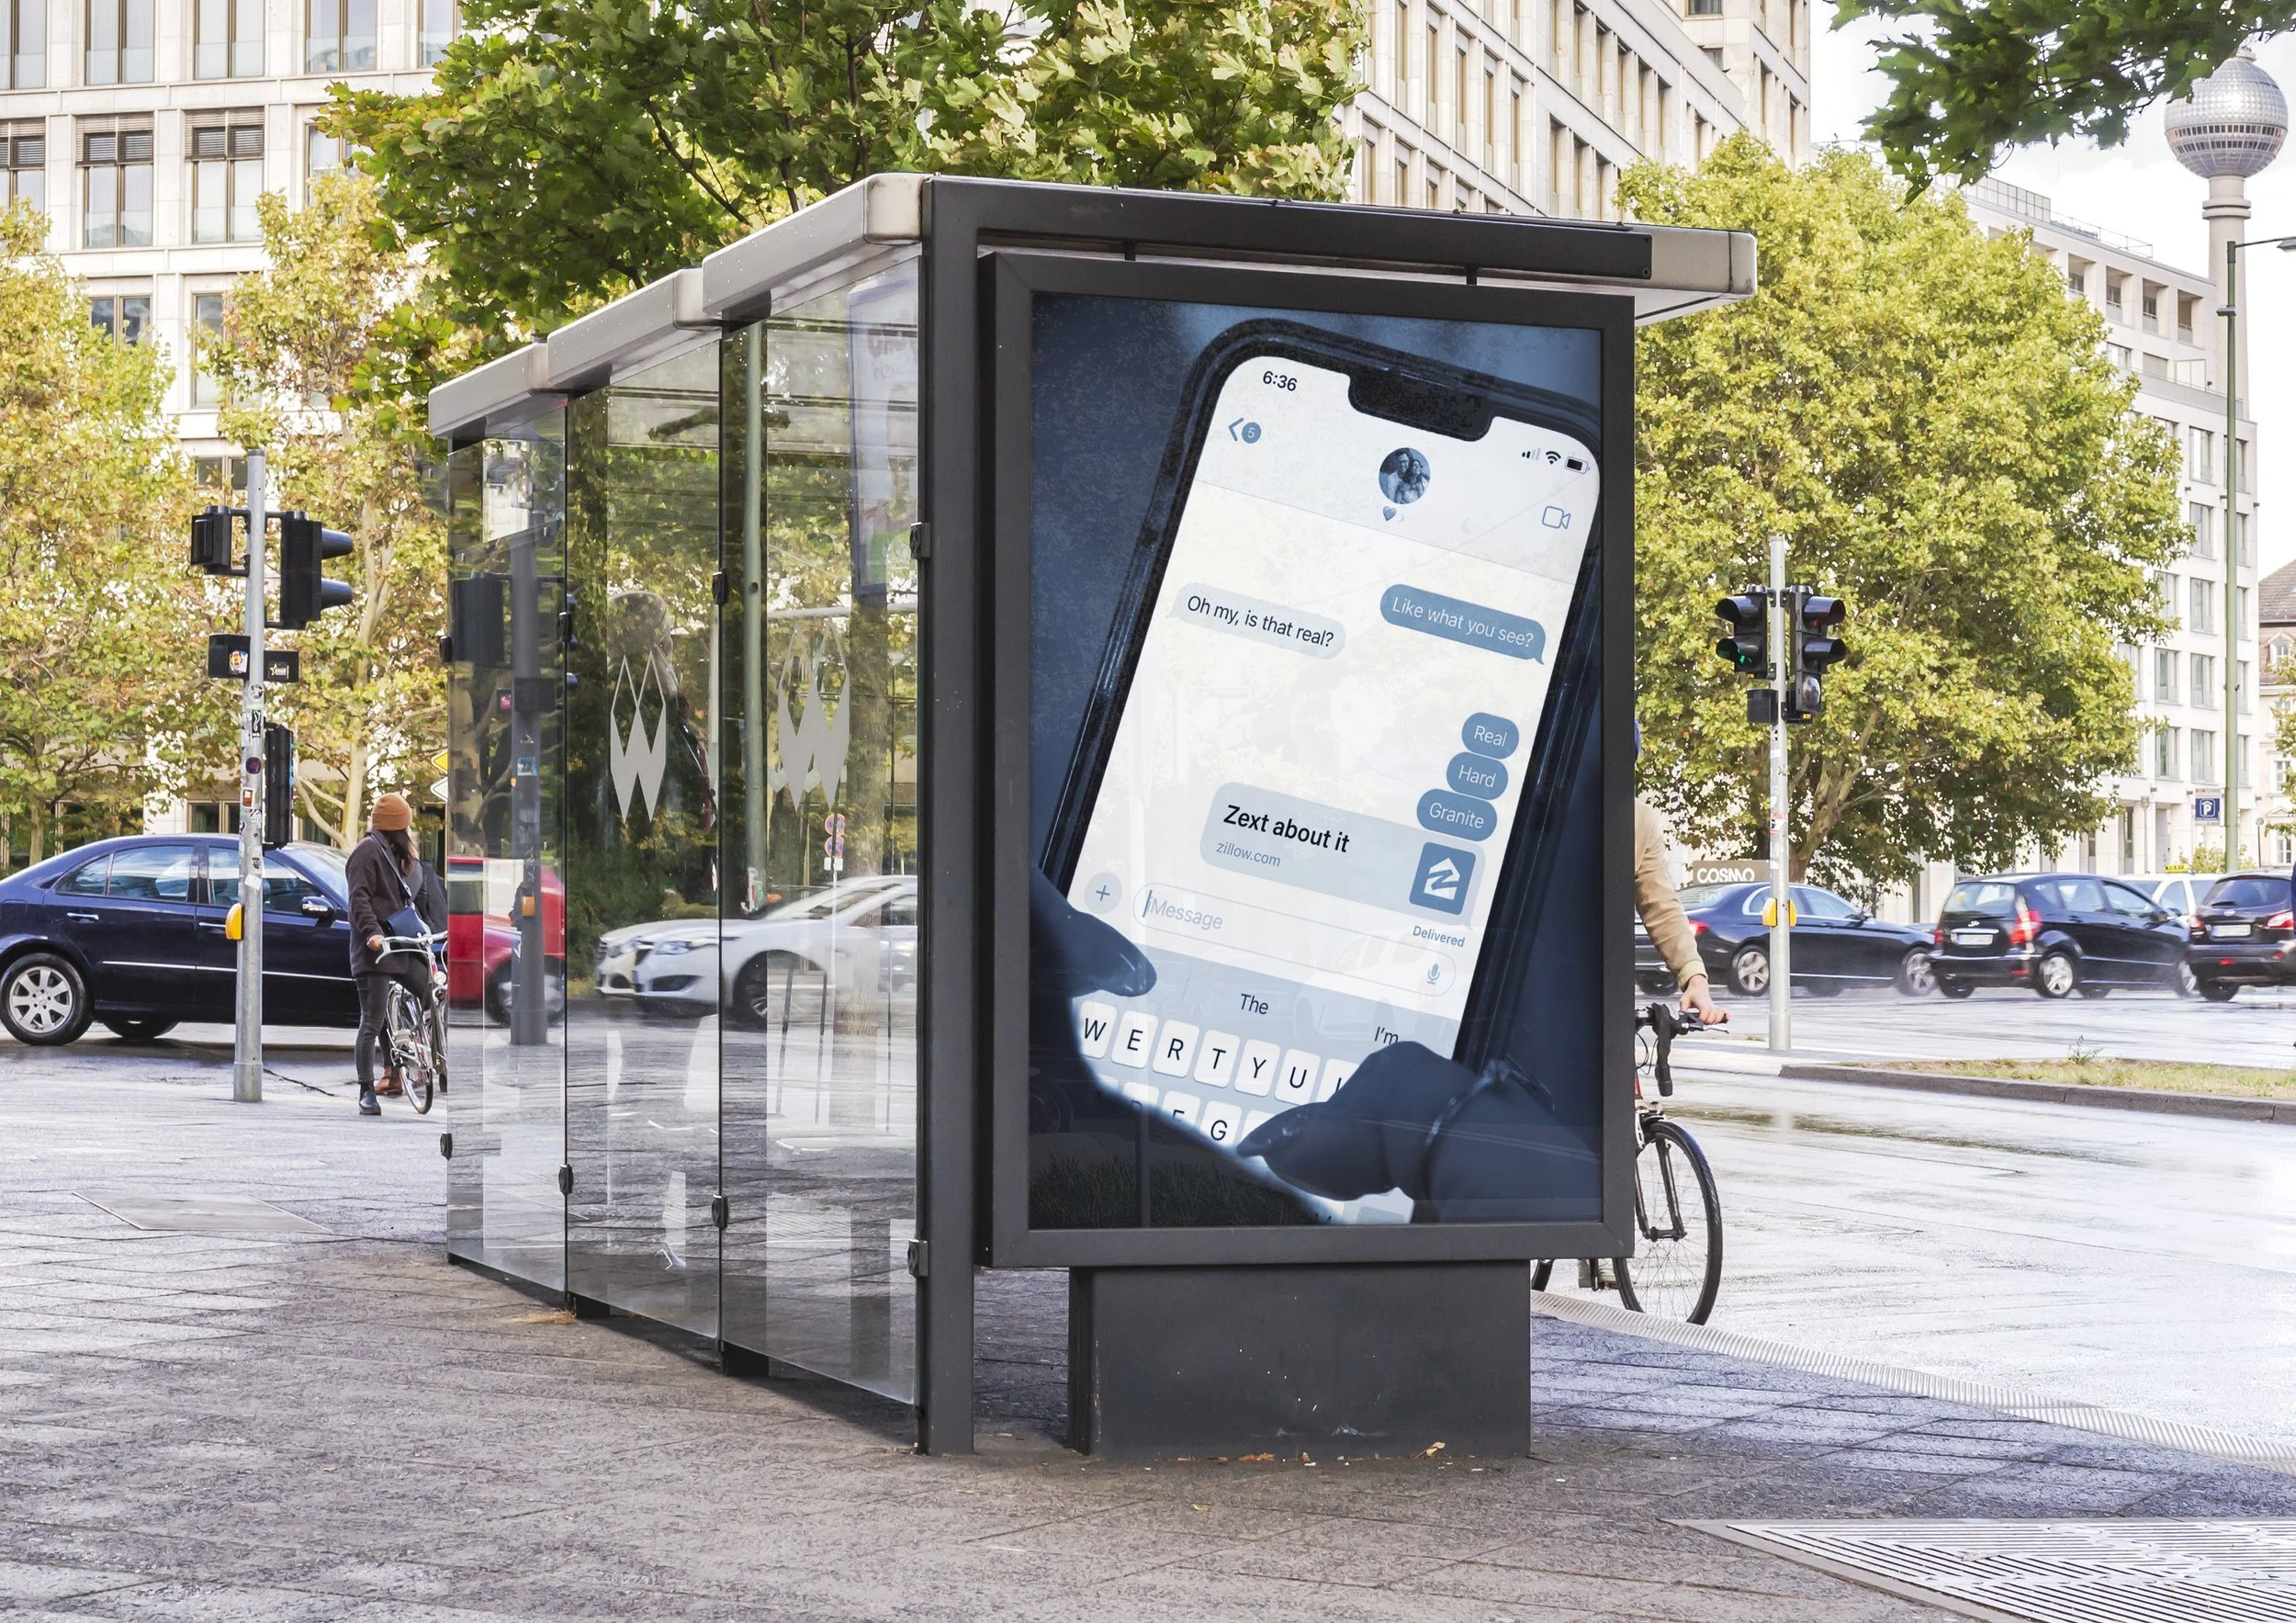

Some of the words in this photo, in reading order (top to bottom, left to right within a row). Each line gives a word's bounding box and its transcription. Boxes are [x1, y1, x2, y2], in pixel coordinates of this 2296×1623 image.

[1263, 370, 1298, 391] 6:36
[1246, 426, 1255, 439] 5
[1187, 595, 1210, 615] Oh
[1213, 604, 1239, 626] my,
[1244, 609, 1258, 627] is
[1262, 615, 1293, 637] that
[1296, 626, 1334, 648] real?
[1392, 596, 1424, 618] Like
[1427, 609, 1464, 629] what
[1466, 620, 1495, 638] you
[1497, 628, 1535, 648] see?
[1473, 725, 1508, 748] Real
[1458, 764, 1497, 788] Hard
[1429, 802, 1484, 829] Granite
[1223, 804, 1270, 833] Zext
[1272, 817, 1332, 849] about
[1334, 831, 1350, 853] it
[1216, 841, 1281, 867] zillow.com
[1696, 867, 1756, 884] COSMO
[1412, 925, 1466, 948] Delivered
[1241, 993, 1269, 1015] The
[1084, 1018, 1107, 1042] W
[1127, 1029, 1143, 1051] E
[1167, 1038, 1184, 1061] R
[1212, 1047, 1227, 1069] T
[1253, 1056, 1267, 1078] Y
[1289, 1066, 1308, 1088] U
[1210, 1120, 1228, 1141] G
